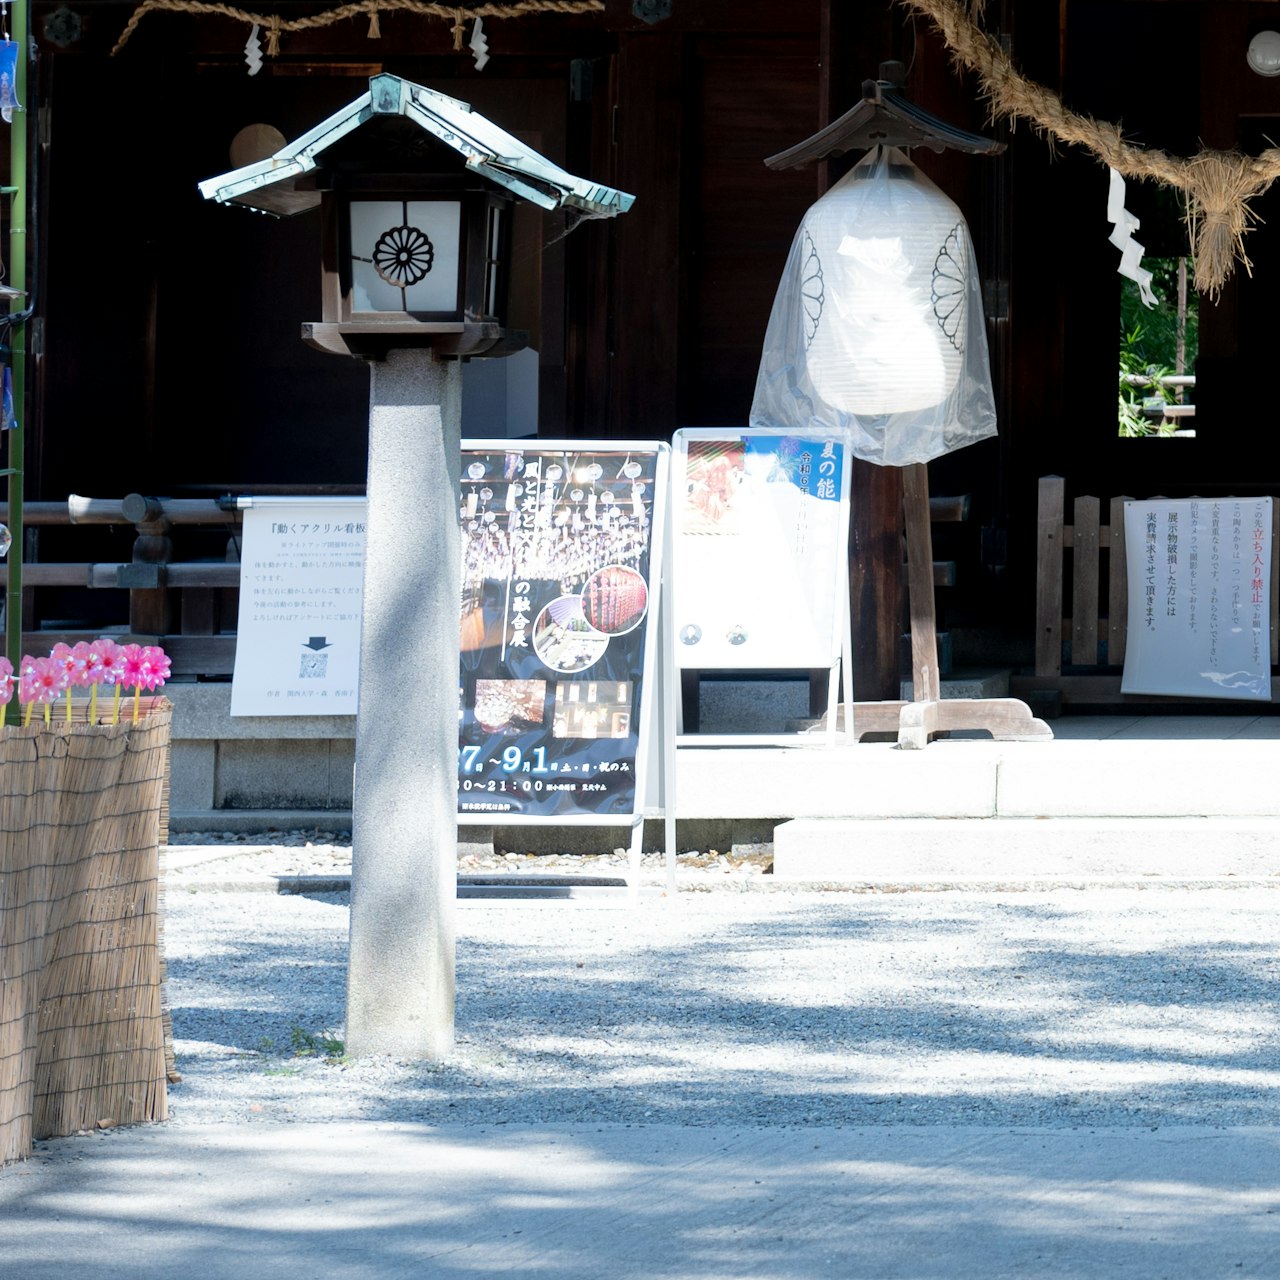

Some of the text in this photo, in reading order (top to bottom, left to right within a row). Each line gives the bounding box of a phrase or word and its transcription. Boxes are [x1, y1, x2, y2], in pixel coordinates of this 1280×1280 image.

[817, 440, 837, 499] 夏の能
[1144, 512, 1157, 631] 実費請求させて頂きます。
[1166, 512, 1179, 616] 展示物破損した方には
